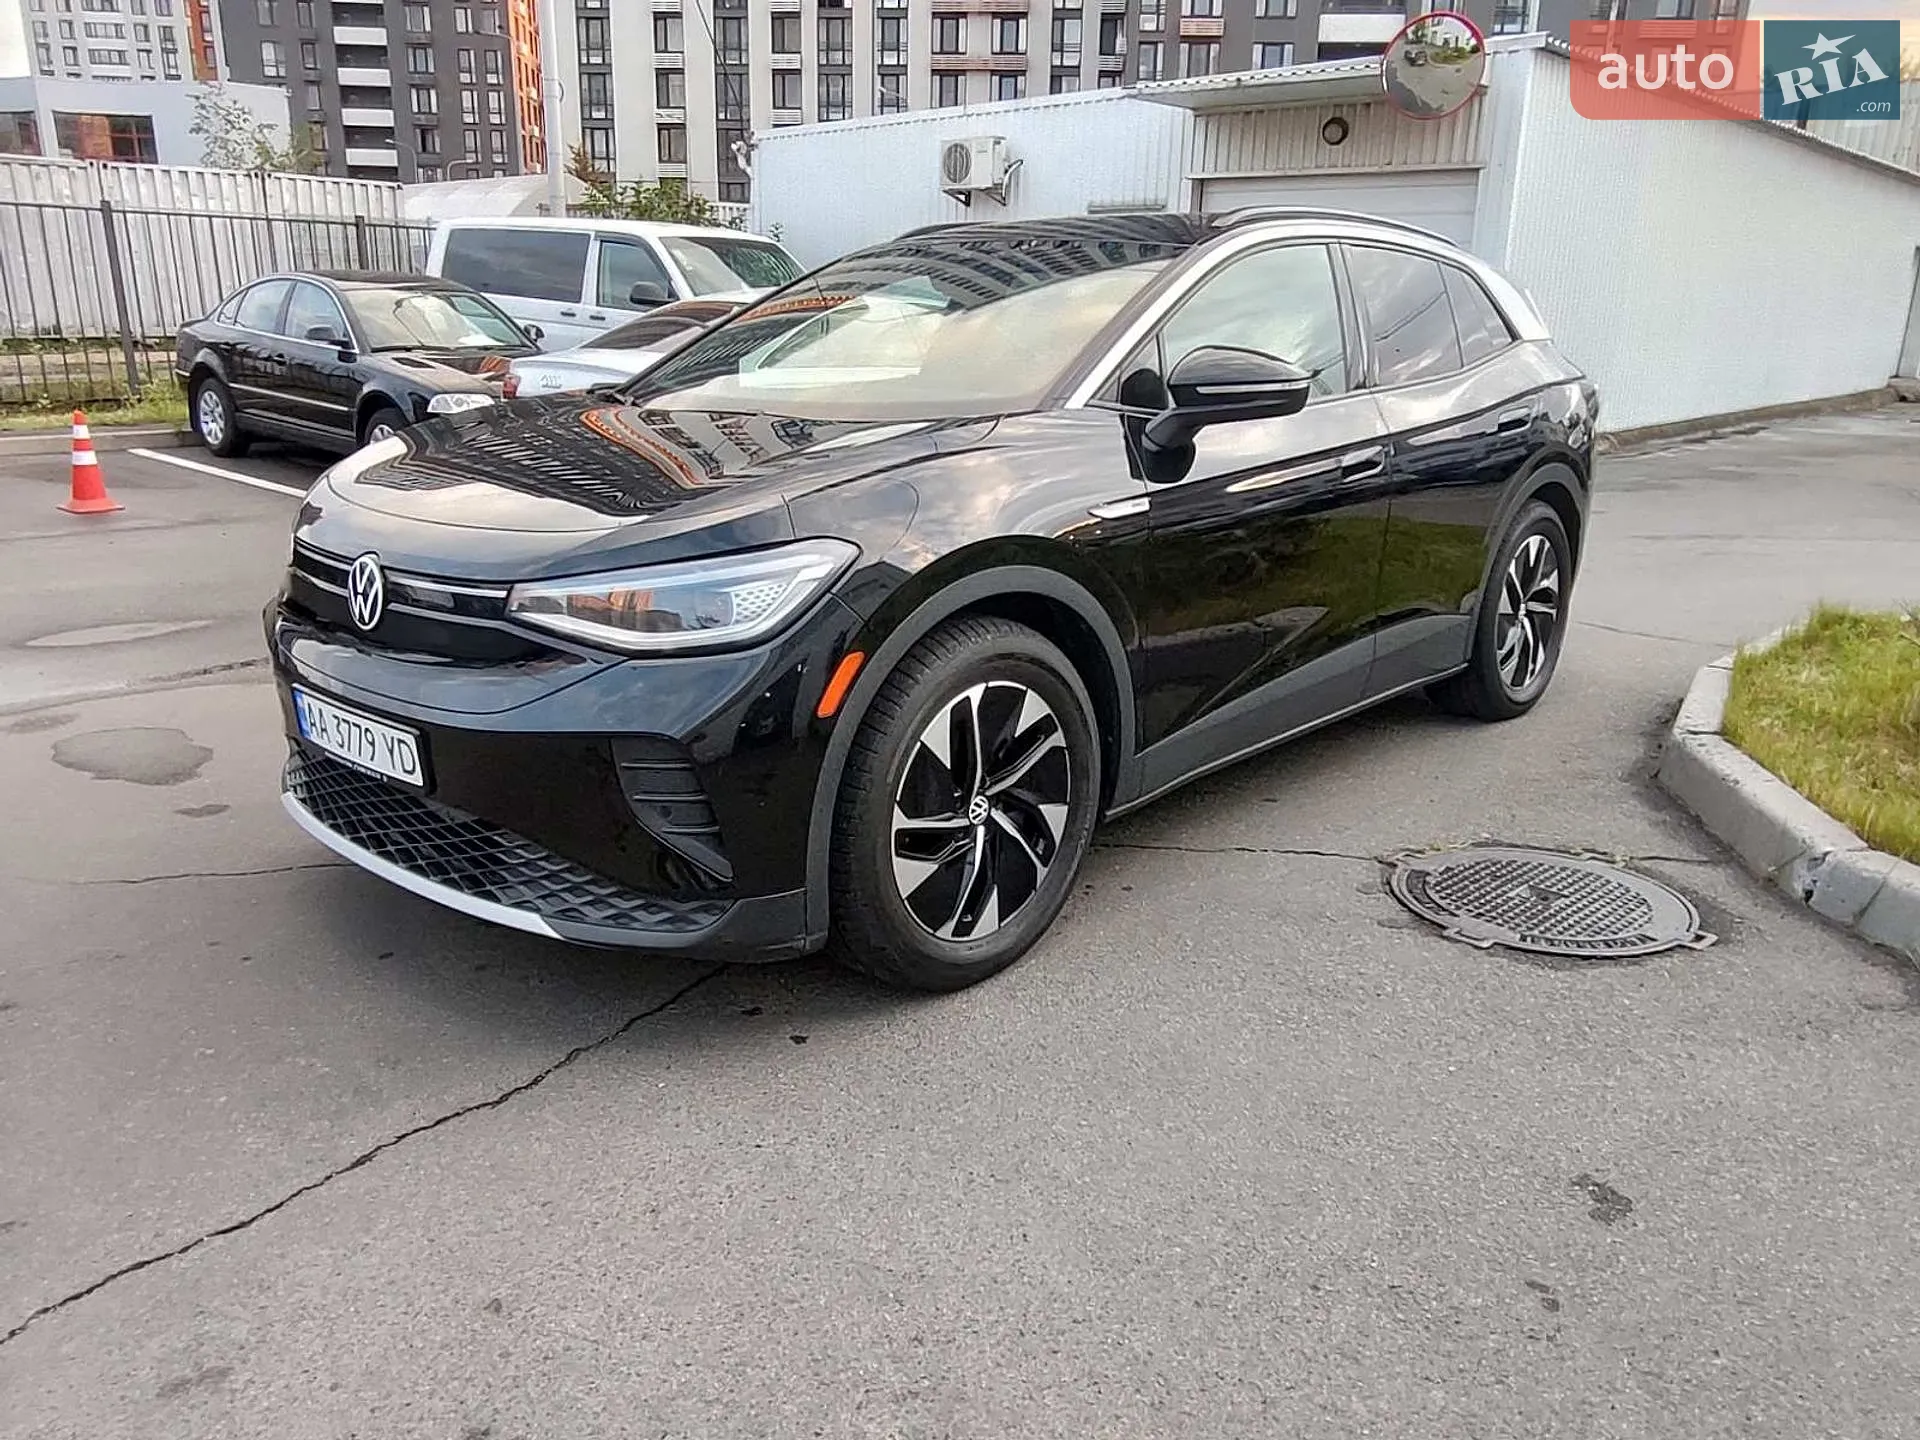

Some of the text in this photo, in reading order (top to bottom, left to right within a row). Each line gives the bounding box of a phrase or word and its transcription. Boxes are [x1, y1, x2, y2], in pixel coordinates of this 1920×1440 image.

[307, 702, 331, 744] AA
[332, 714, 376, 762] 3779
[381, 733, 416, 775] YD
